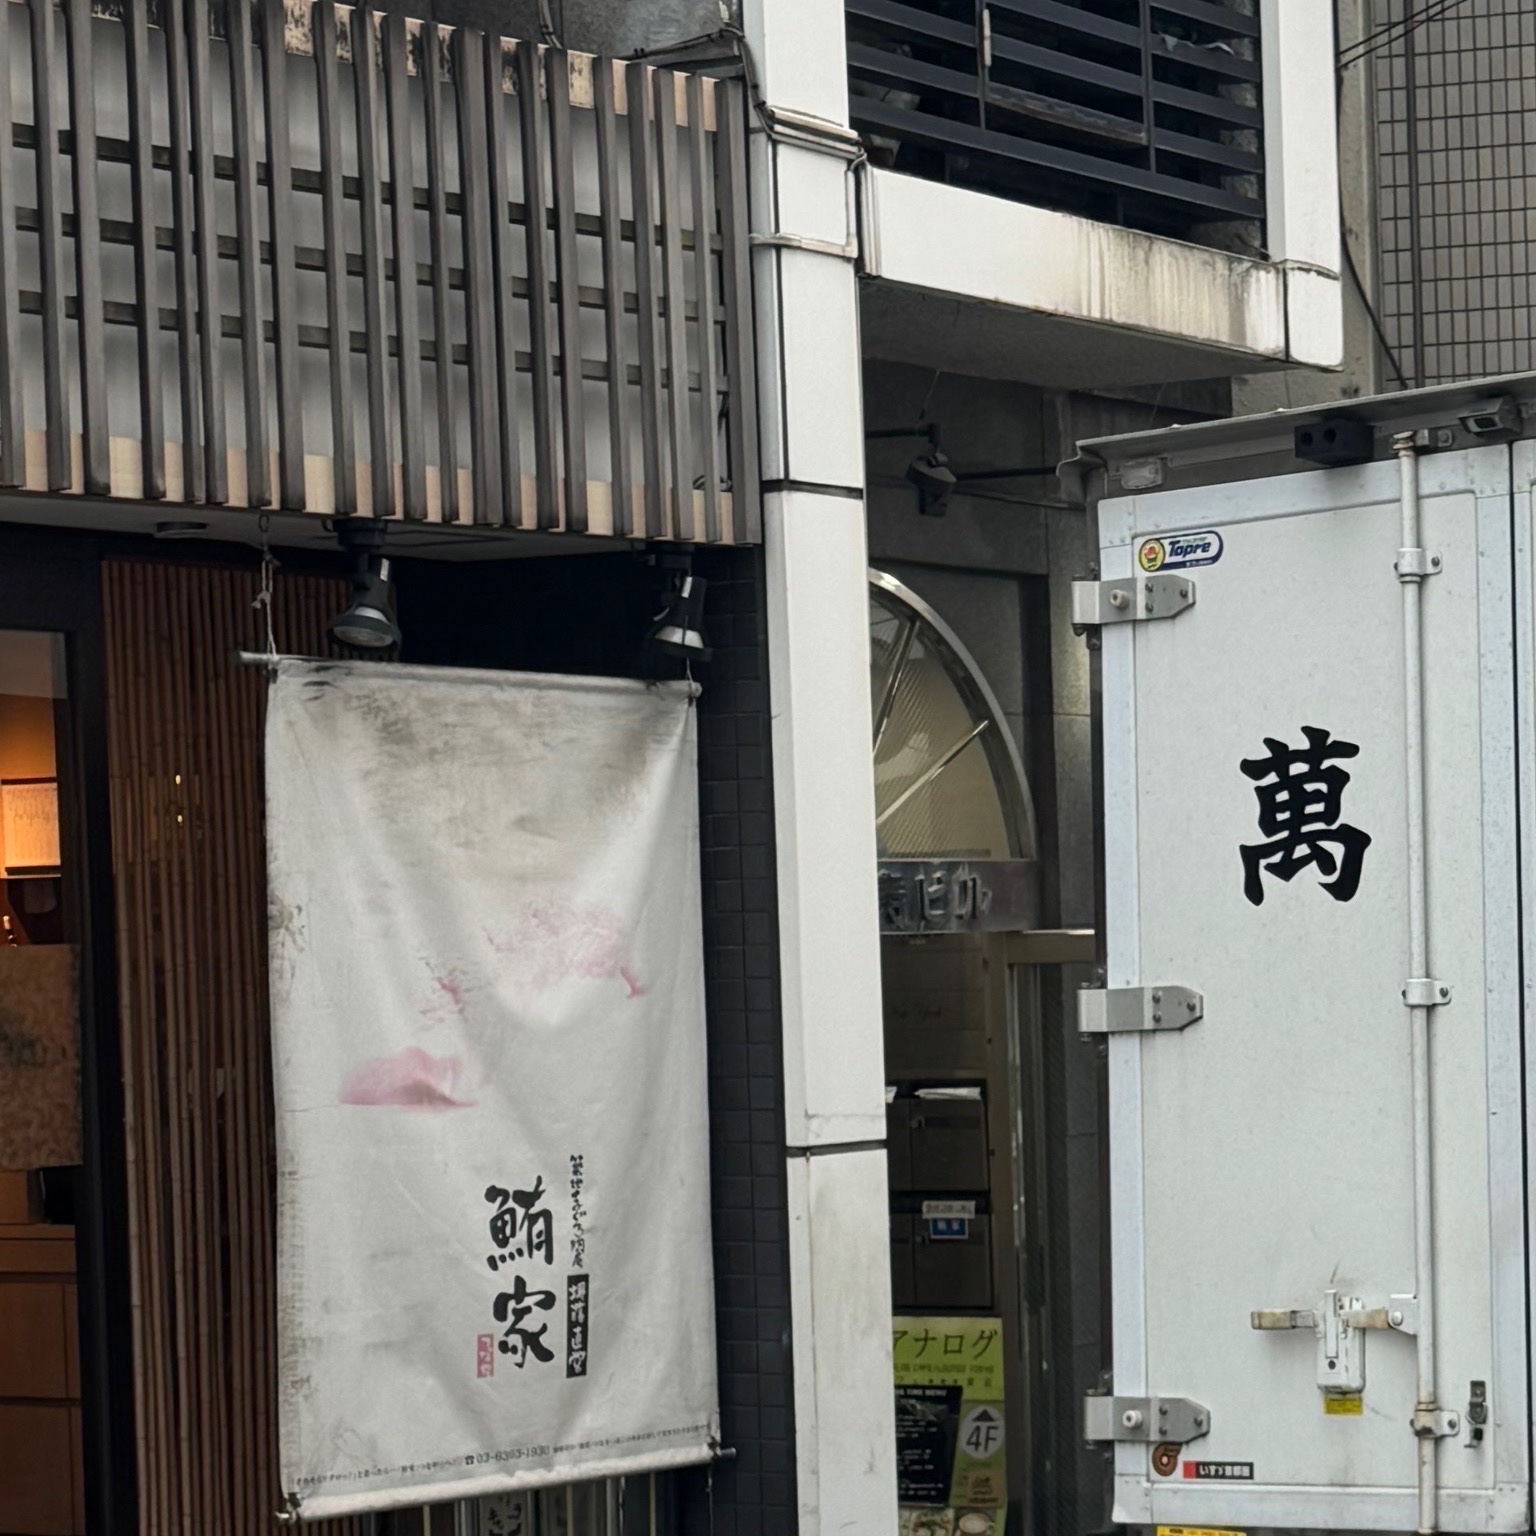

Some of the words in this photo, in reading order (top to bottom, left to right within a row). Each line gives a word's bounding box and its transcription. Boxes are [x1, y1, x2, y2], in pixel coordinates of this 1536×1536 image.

[1168, 540, 1212, 558] Topre
[484, 1174, 557, 1369] 鮪家
[892, 1328, 998, 1359] アナログ
[965, 1425, 999, 1453] 4F
